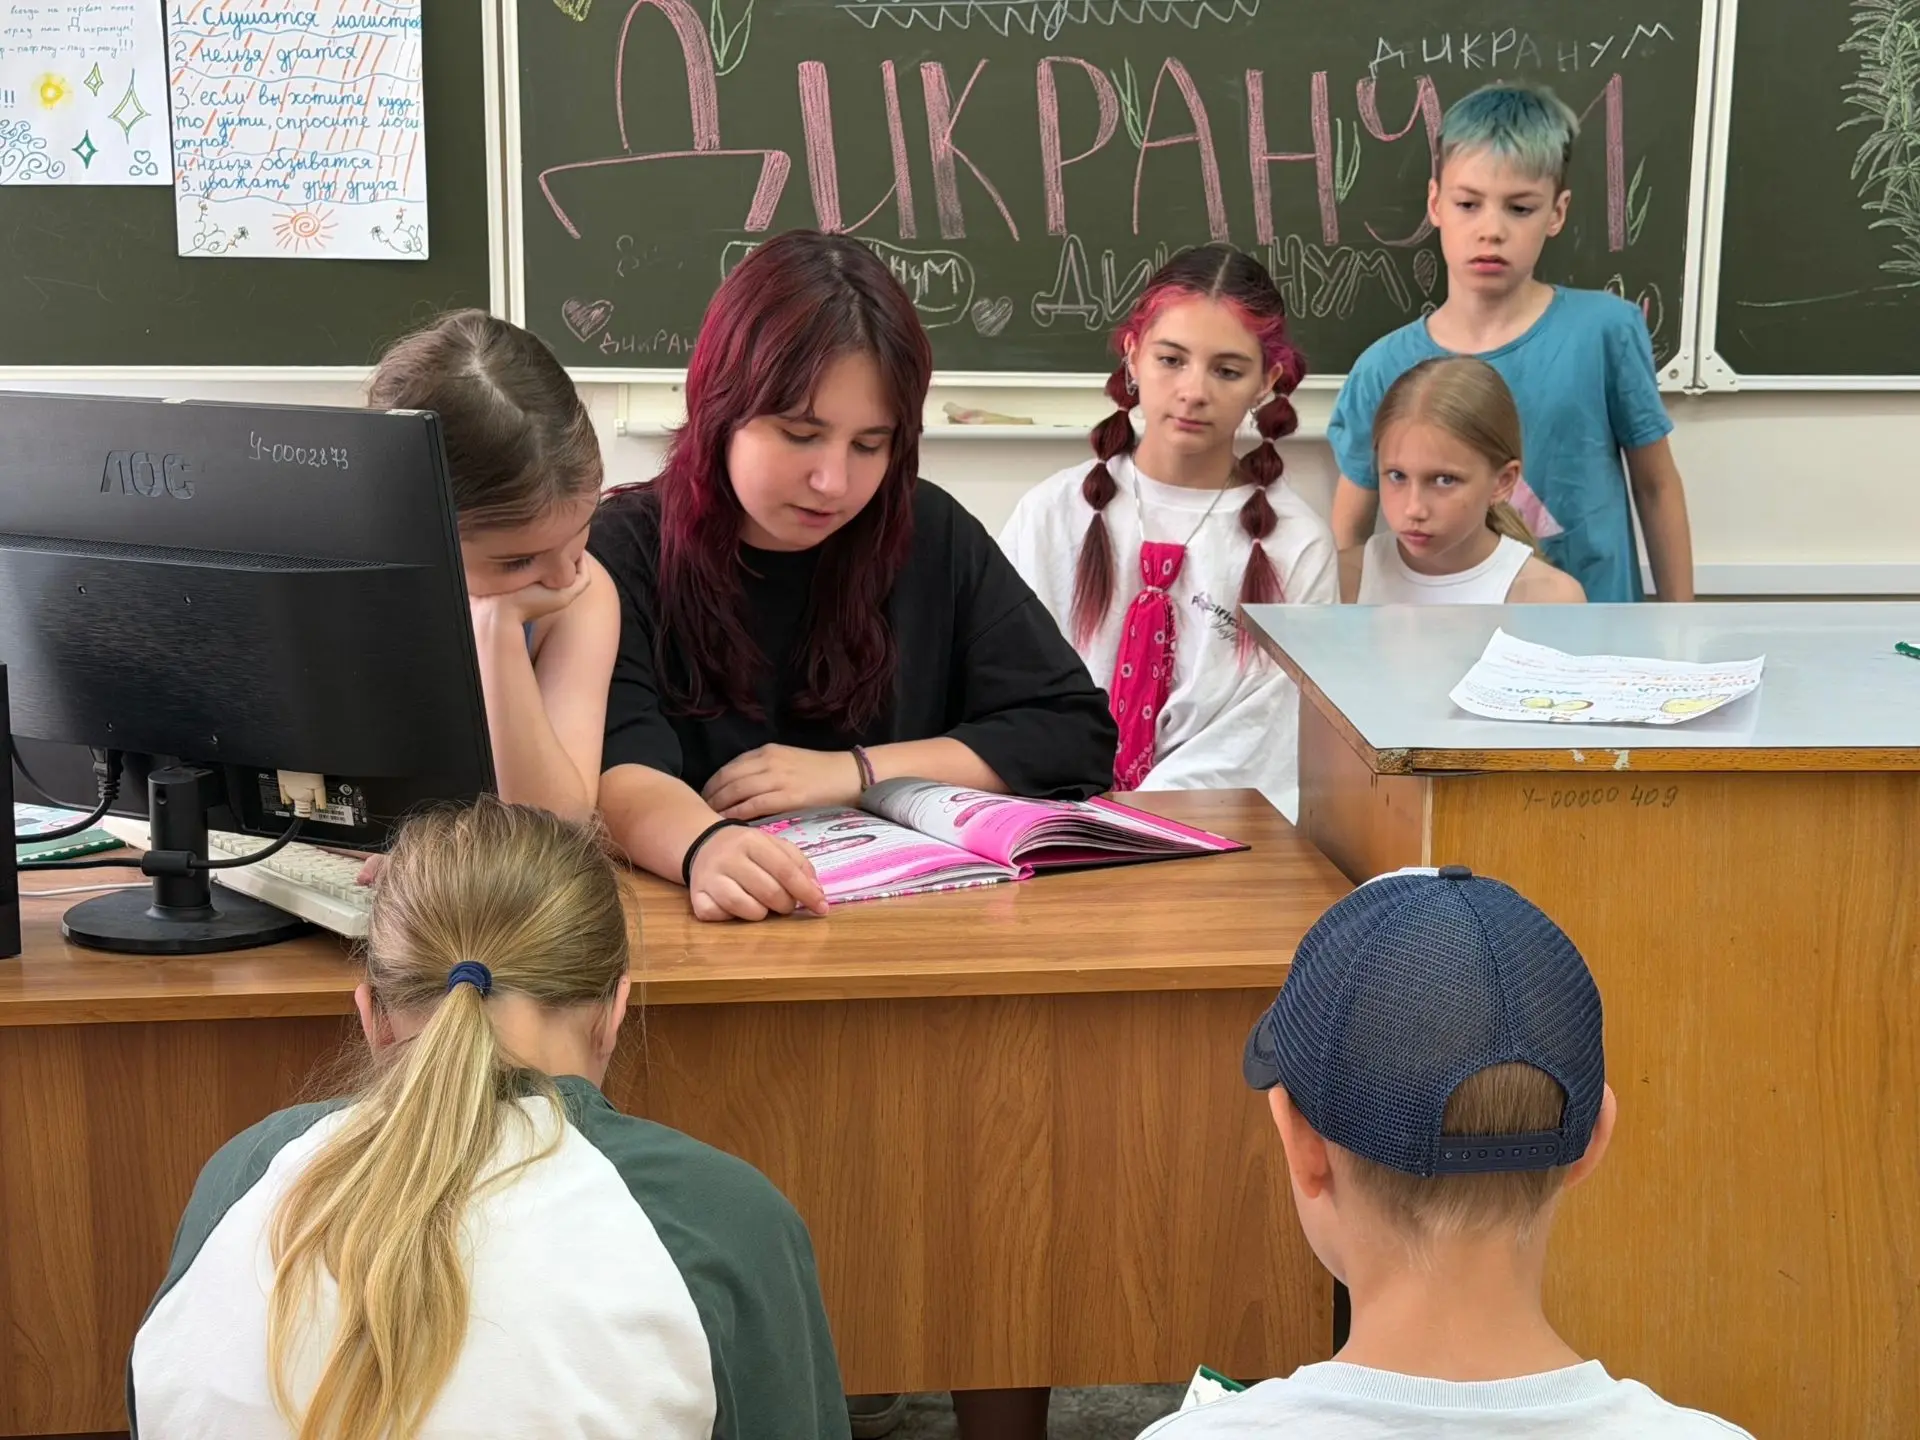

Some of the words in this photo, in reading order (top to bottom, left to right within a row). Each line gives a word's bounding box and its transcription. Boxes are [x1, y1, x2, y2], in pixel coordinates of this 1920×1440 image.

[202, 7, 320, 40] Слушатся
[200, 46, 264, 72] нельзя
[1368, 22, 1675, 80] ДИКРАНУМ
[199, 91, 246, 107] если
[288, 91, 366, 107] хотите
[275, 114, 370, 139] спросите
[197, 158, 253, 178] нельзя
[199, 171, 290, 200] уважать
